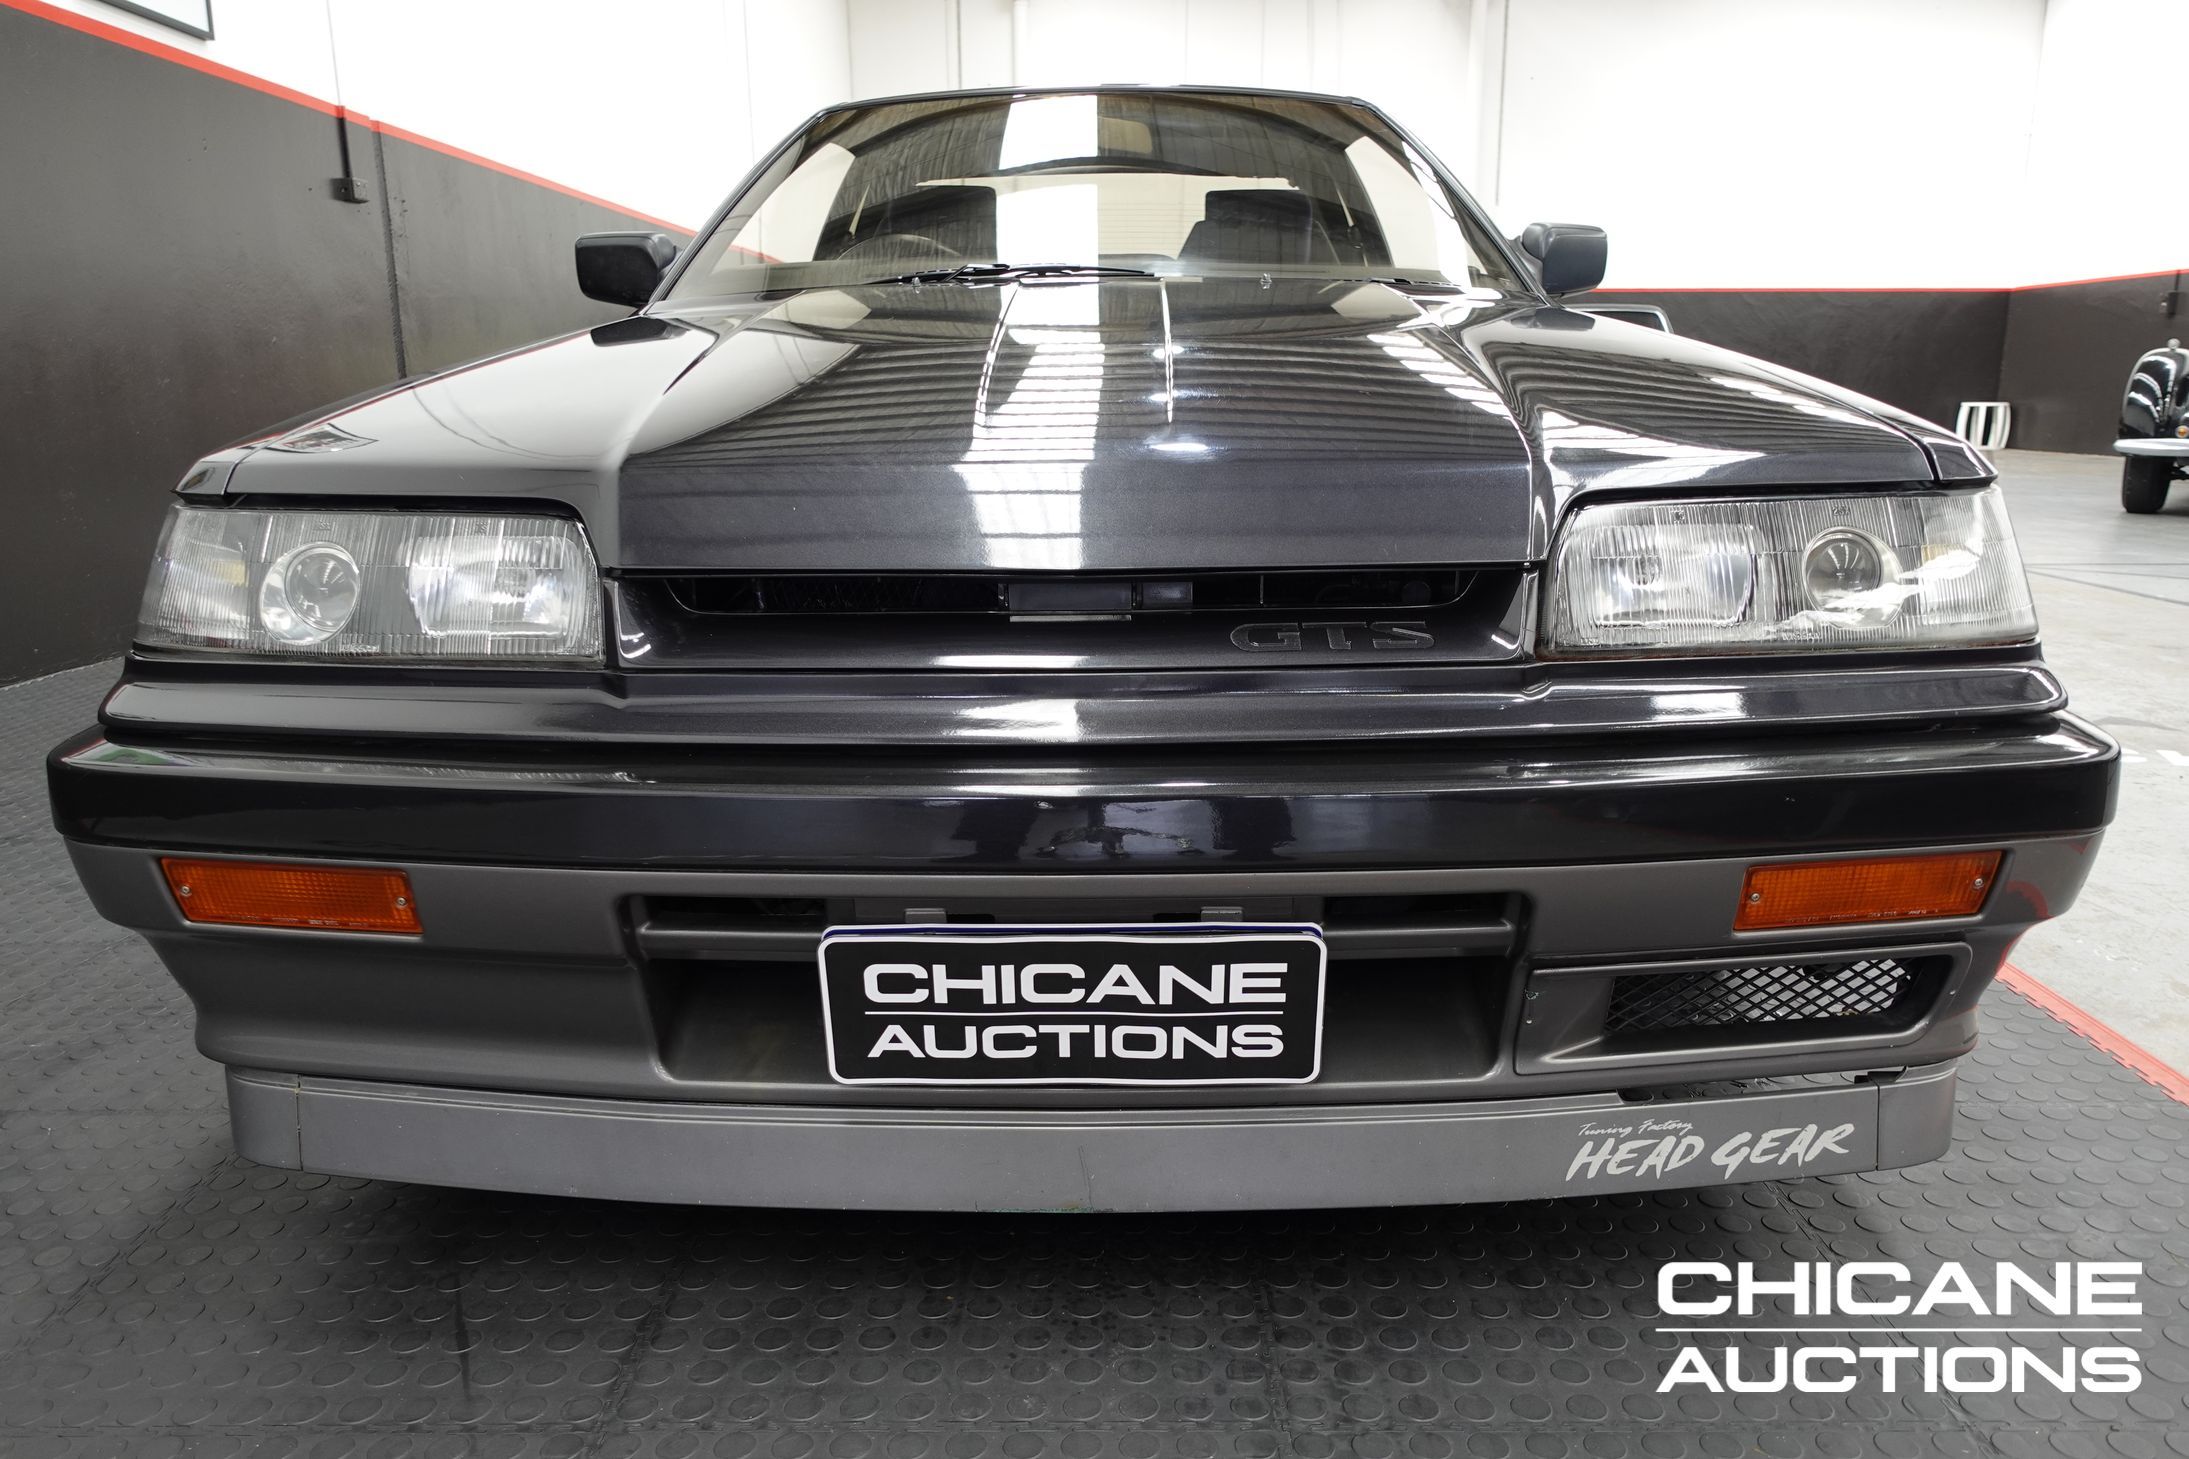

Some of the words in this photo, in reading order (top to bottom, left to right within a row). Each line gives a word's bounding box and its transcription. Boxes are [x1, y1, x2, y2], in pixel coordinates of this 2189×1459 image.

[1230, 621, 1435, 651] GTS
[864, 962, 1288, 1005] CHICANE
[867, 1024, 1284, 1060] AUCTIONS
[1578, 1122, 1632, 1137] Tuning
[1638, 1118, 1694, 1136] Factory
[1565, 1135, 1705, 1182] HEAD
[1710, 1123, 1855, 1181] GEAR
